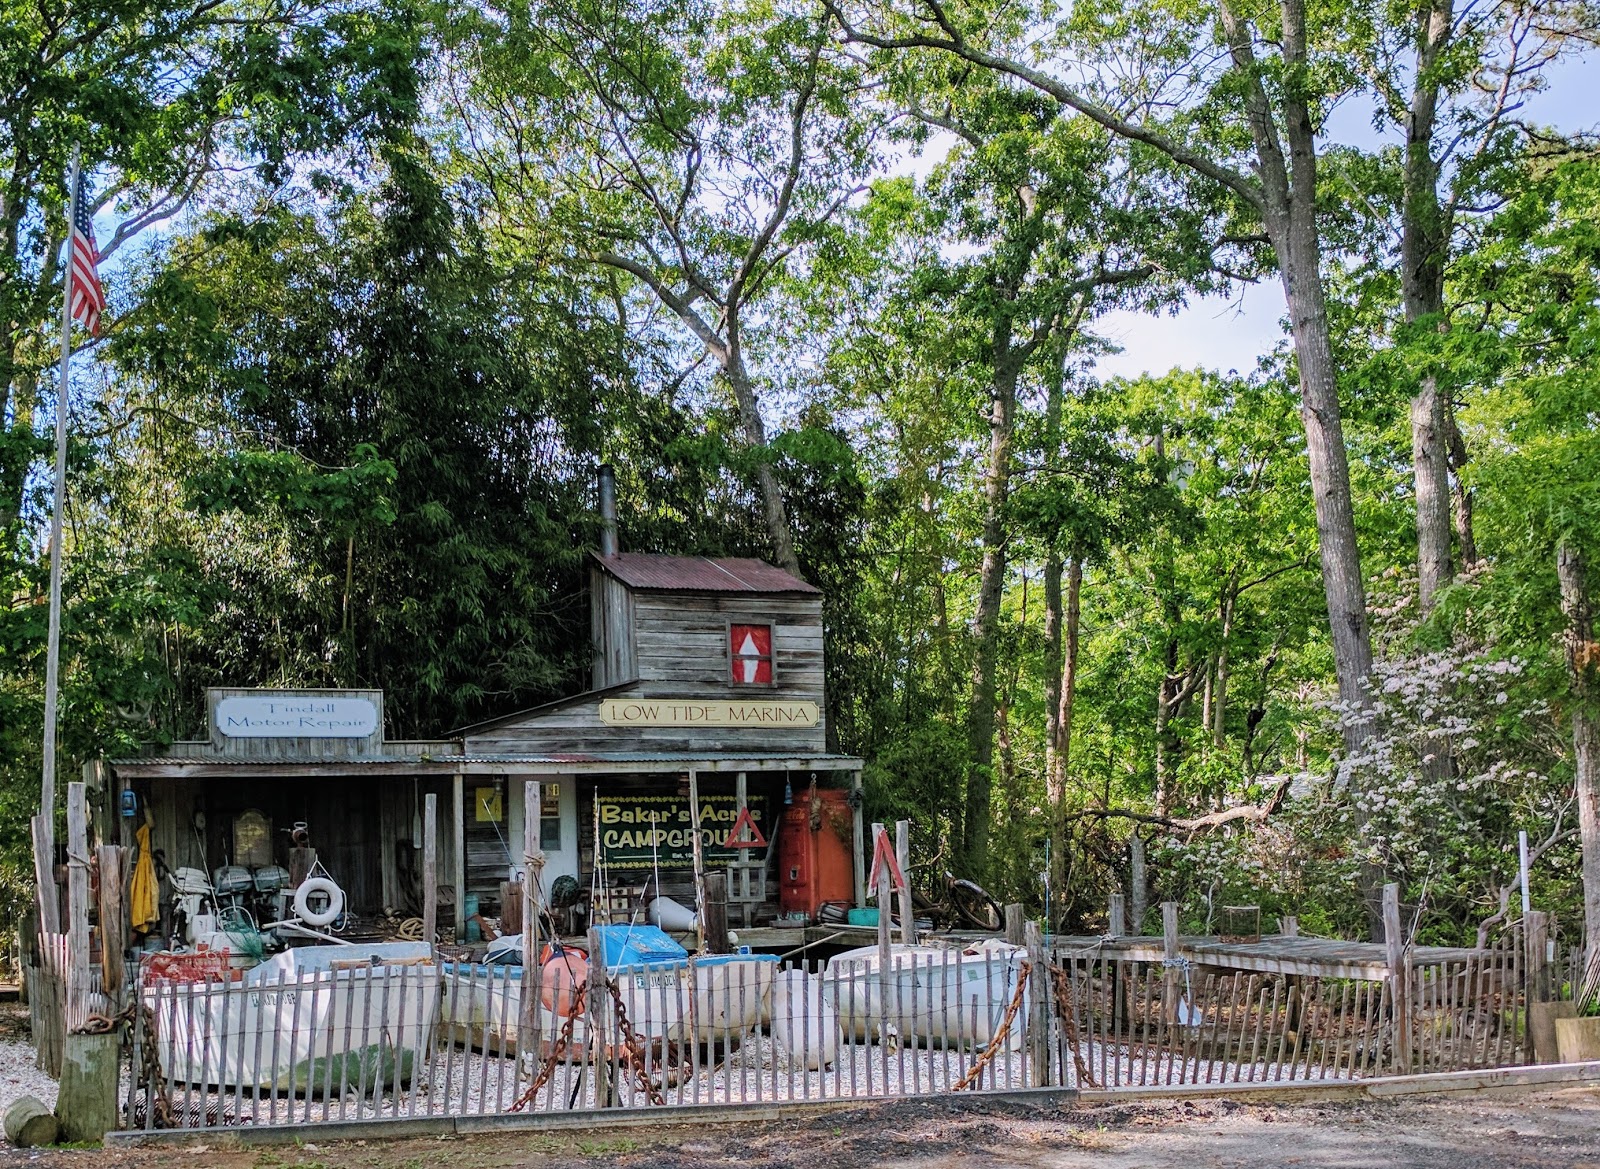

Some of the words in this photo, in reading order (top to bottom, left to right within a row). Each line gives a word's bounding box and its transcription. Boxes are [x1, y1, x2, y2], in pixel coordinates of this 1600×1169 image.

[262, 702, 335, 713] Tindall
[611, 704, 660, 721] LOW
[667, 705, 721, 721] TIDE
[728, 706, 810, 722] MARINA
[227, 716, 295, 727] Motor
[299, 717, 367, 730] Repair
[601, 804, 690, 824] Baker's
[699, 804, 762, 823] Acrs
